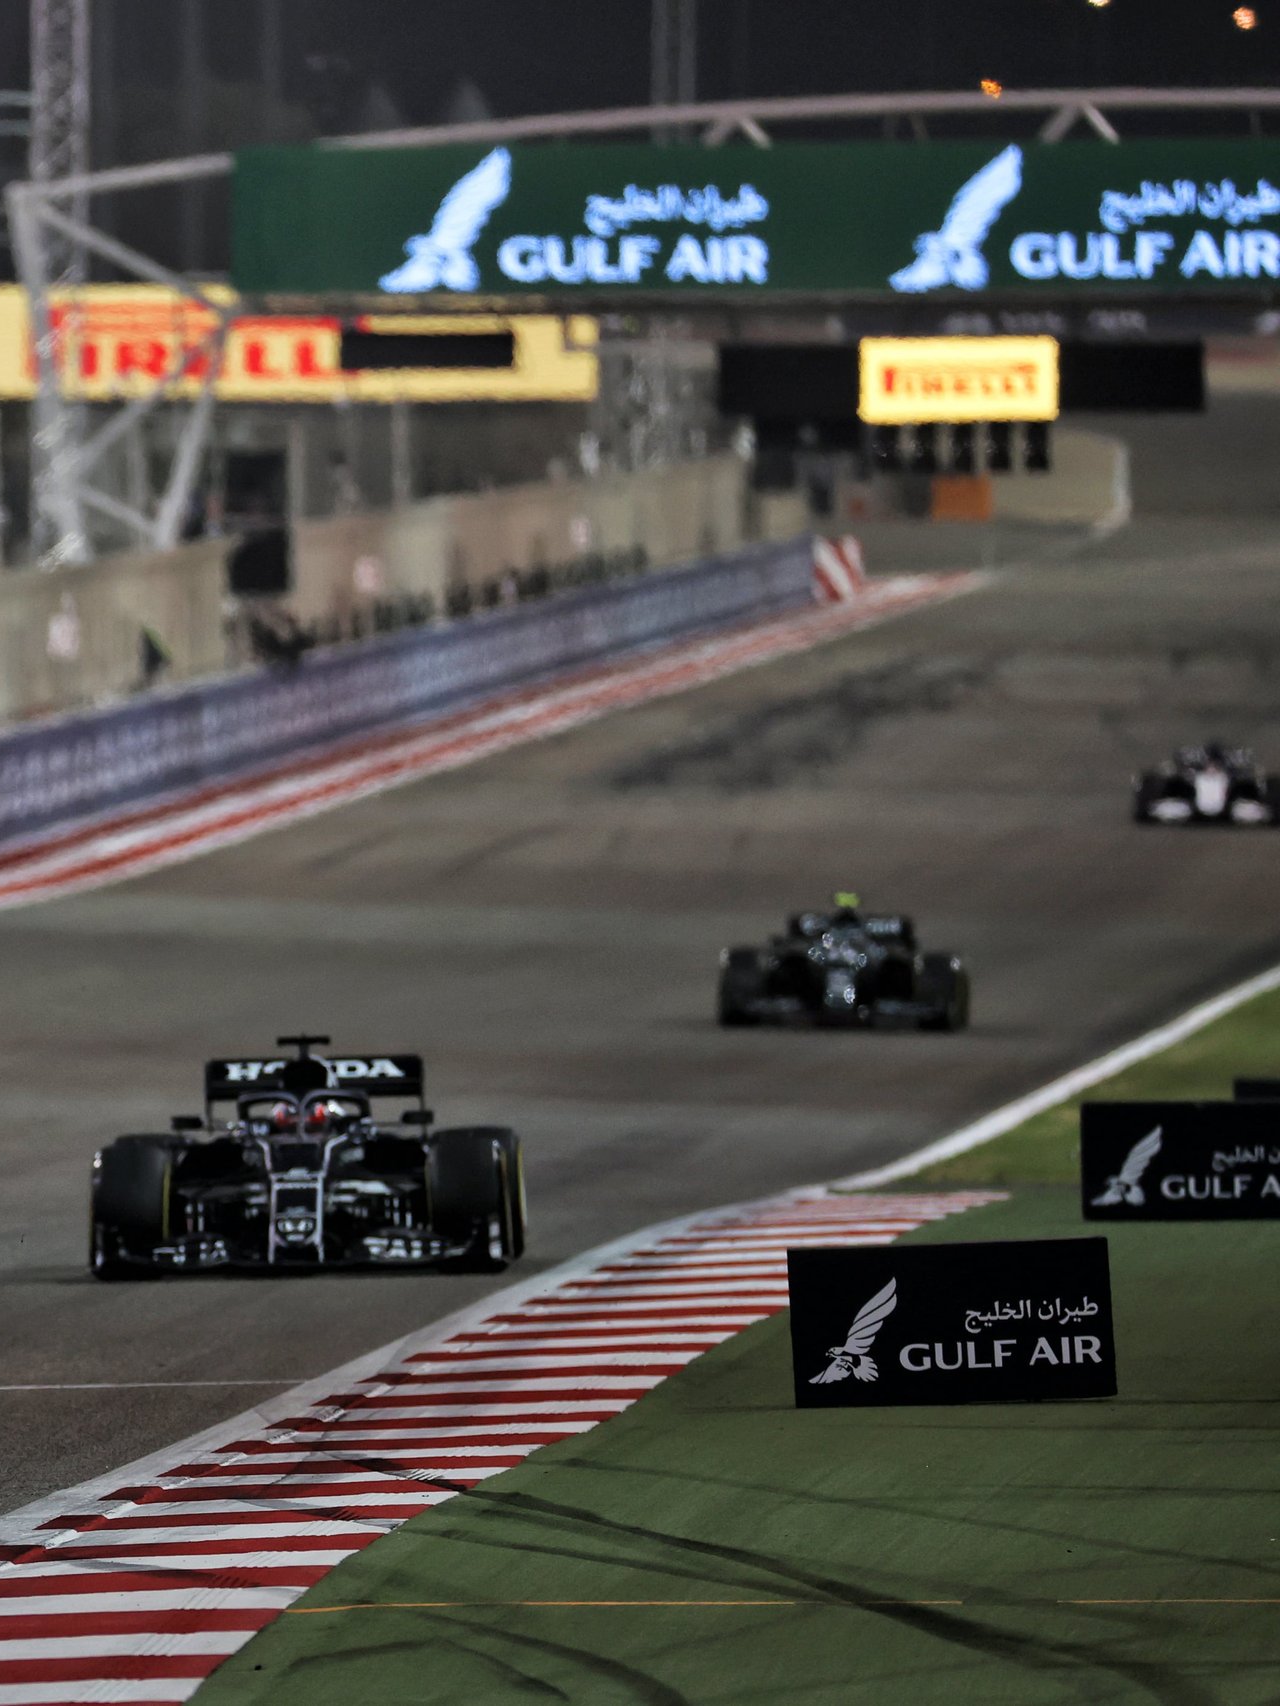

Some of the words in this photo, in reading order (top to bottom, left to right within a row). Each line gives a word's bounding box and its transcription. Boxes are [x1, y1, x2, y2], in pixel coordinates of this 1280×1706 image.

[496, 235, 661, 284] GULF
[664, 234, 770, 284] AIR
[1009, 231, 1175, 281] GULF
[1178, 230, 1280, 280] AIR
[1160, 1173, 1252, 1199] GULF
[964, 1299, 1031, 1334] الخليج
[1038, 1296, 1099, 1325] طيران
[899, 1339, 1017, 1371] GULF
[1029, 1335, 1102, 1367] AIR
